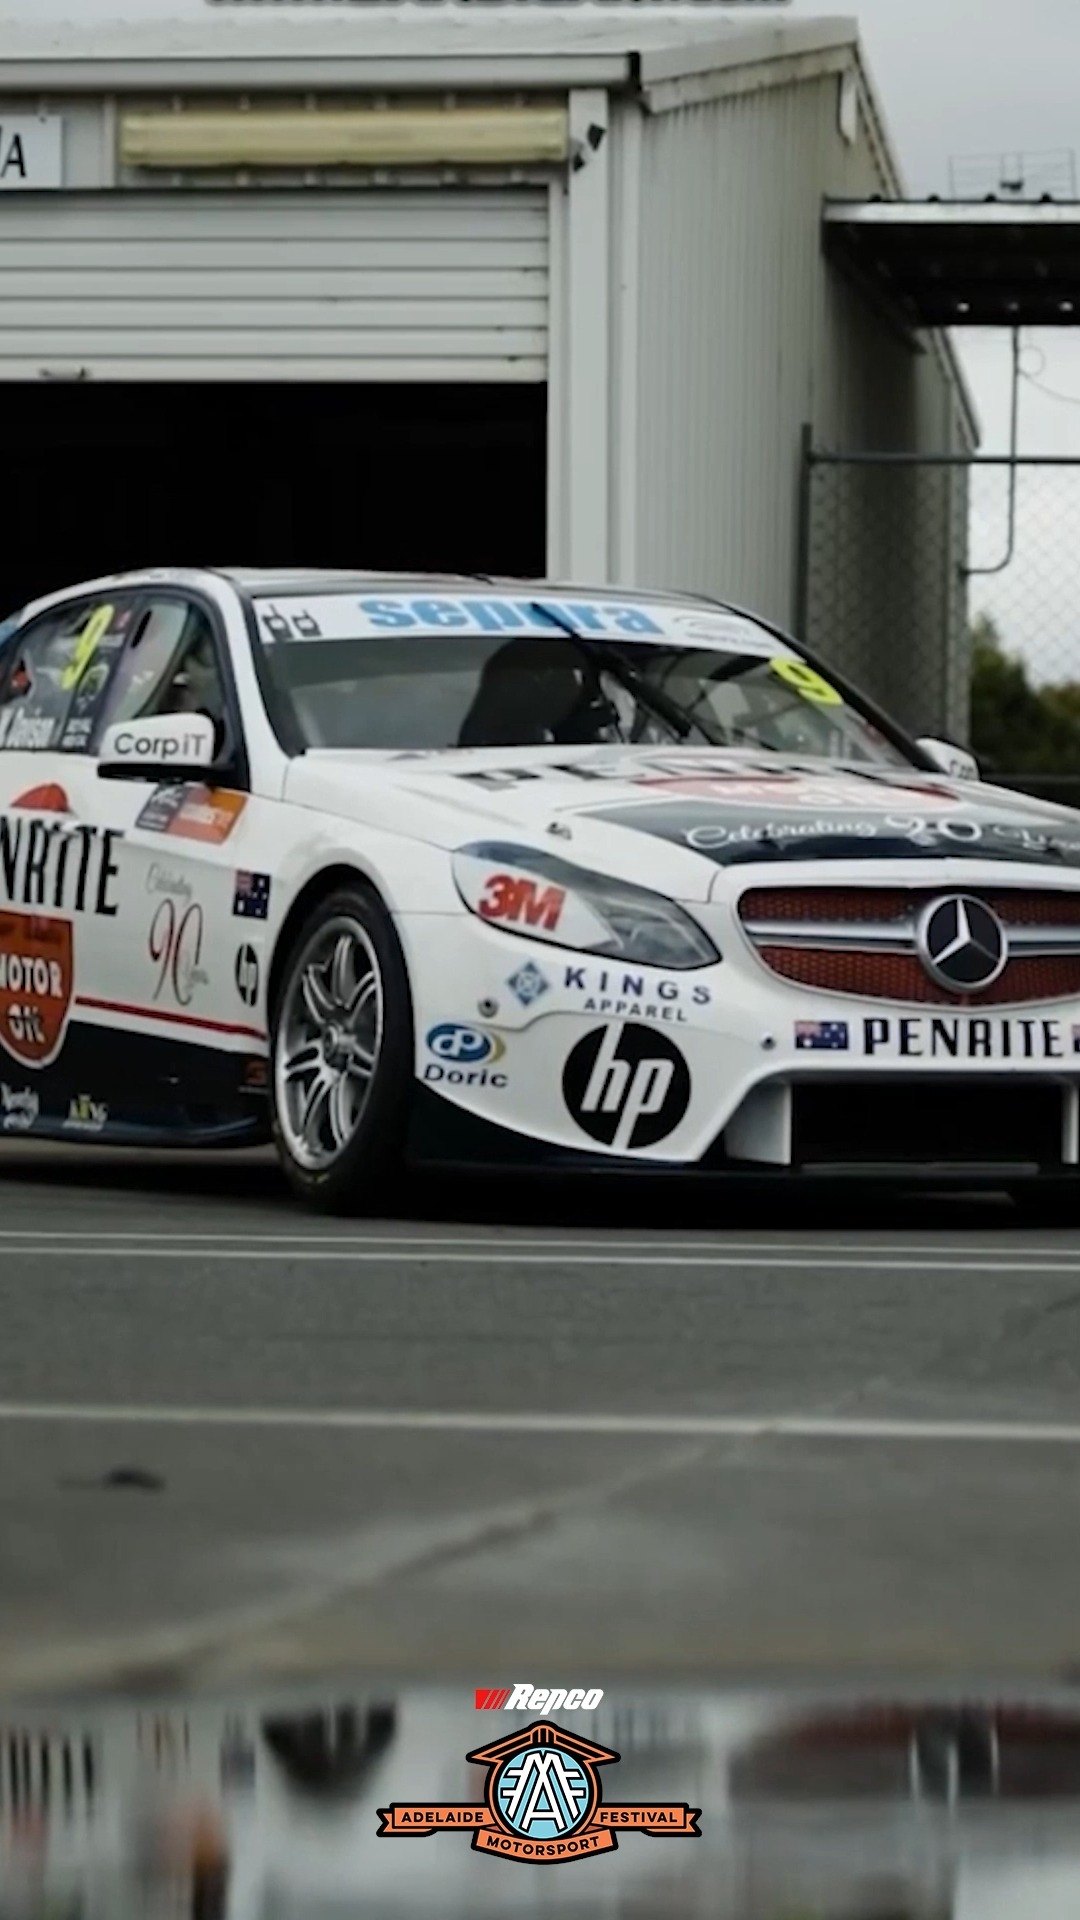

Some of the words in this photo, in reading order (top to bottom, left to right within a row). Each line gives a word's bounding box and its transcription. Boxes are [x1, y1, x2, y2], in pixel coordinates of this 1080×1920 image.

[0, 125, 26, 178] A
[358, 599, 664, 634] sepura
[60, 603, 114, 690] 9
[769, 656, 845, 706] 9
[884, 815, 982, 847] 90
[478, 873, 567, 932] 3M
[564, 966, 712, 1006] KINGS
[584, 997, 688, 1023] APPAREL
[863, 1017, 1063, 1057] PENRITE
[423, 1064, 509, 1088] Doric
[580, 1020, 676, 1151] hp
